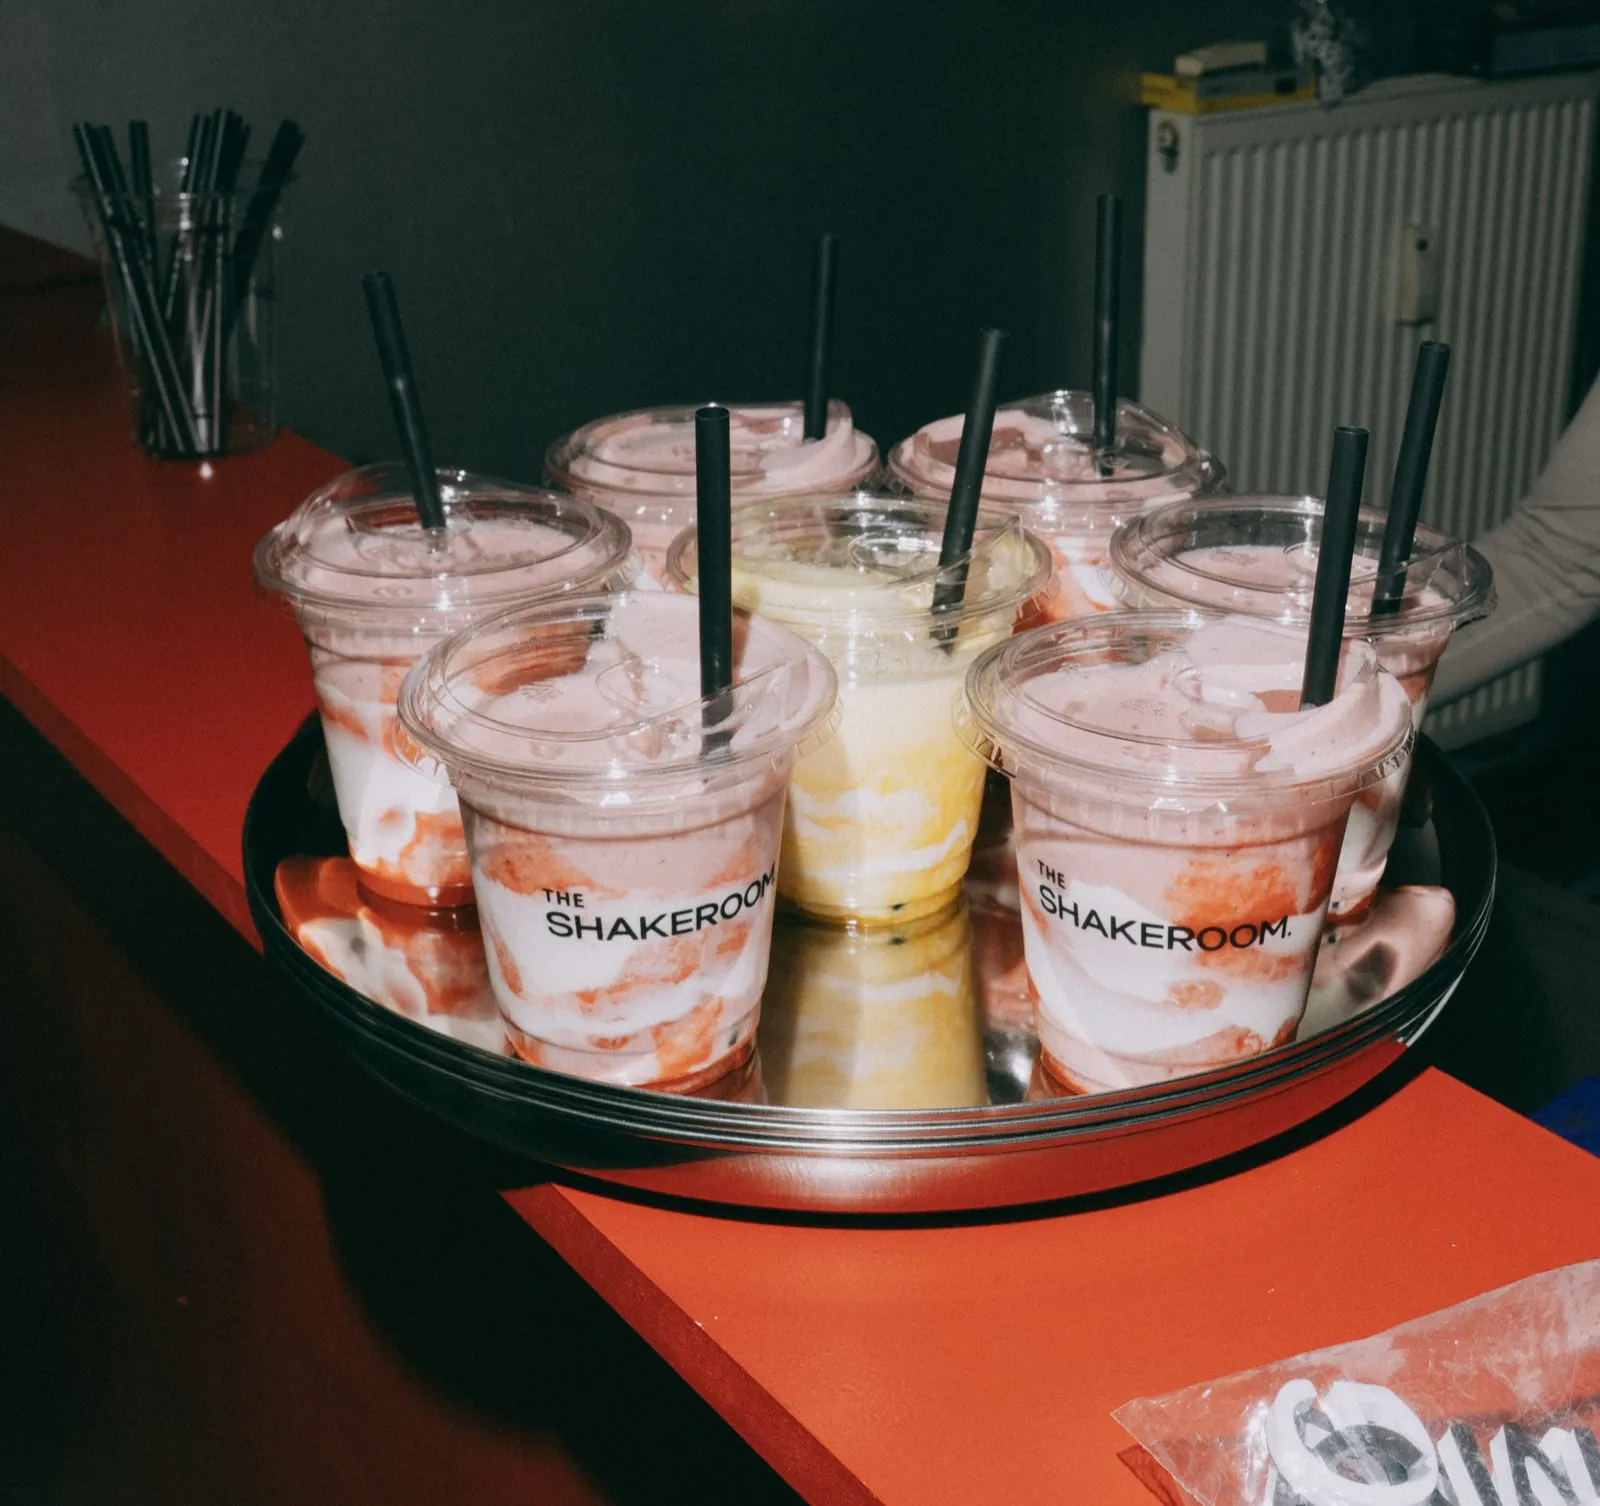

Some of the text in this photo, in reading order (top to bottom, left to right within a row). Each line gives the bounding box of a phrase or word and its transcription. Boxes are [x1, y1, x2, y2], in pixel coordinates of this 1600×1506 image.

[1037, 859, 1066, 891] THE
[542, 888, 584, 908] THE
[1039, 884, 1292, 951] SHAKEROOM.
